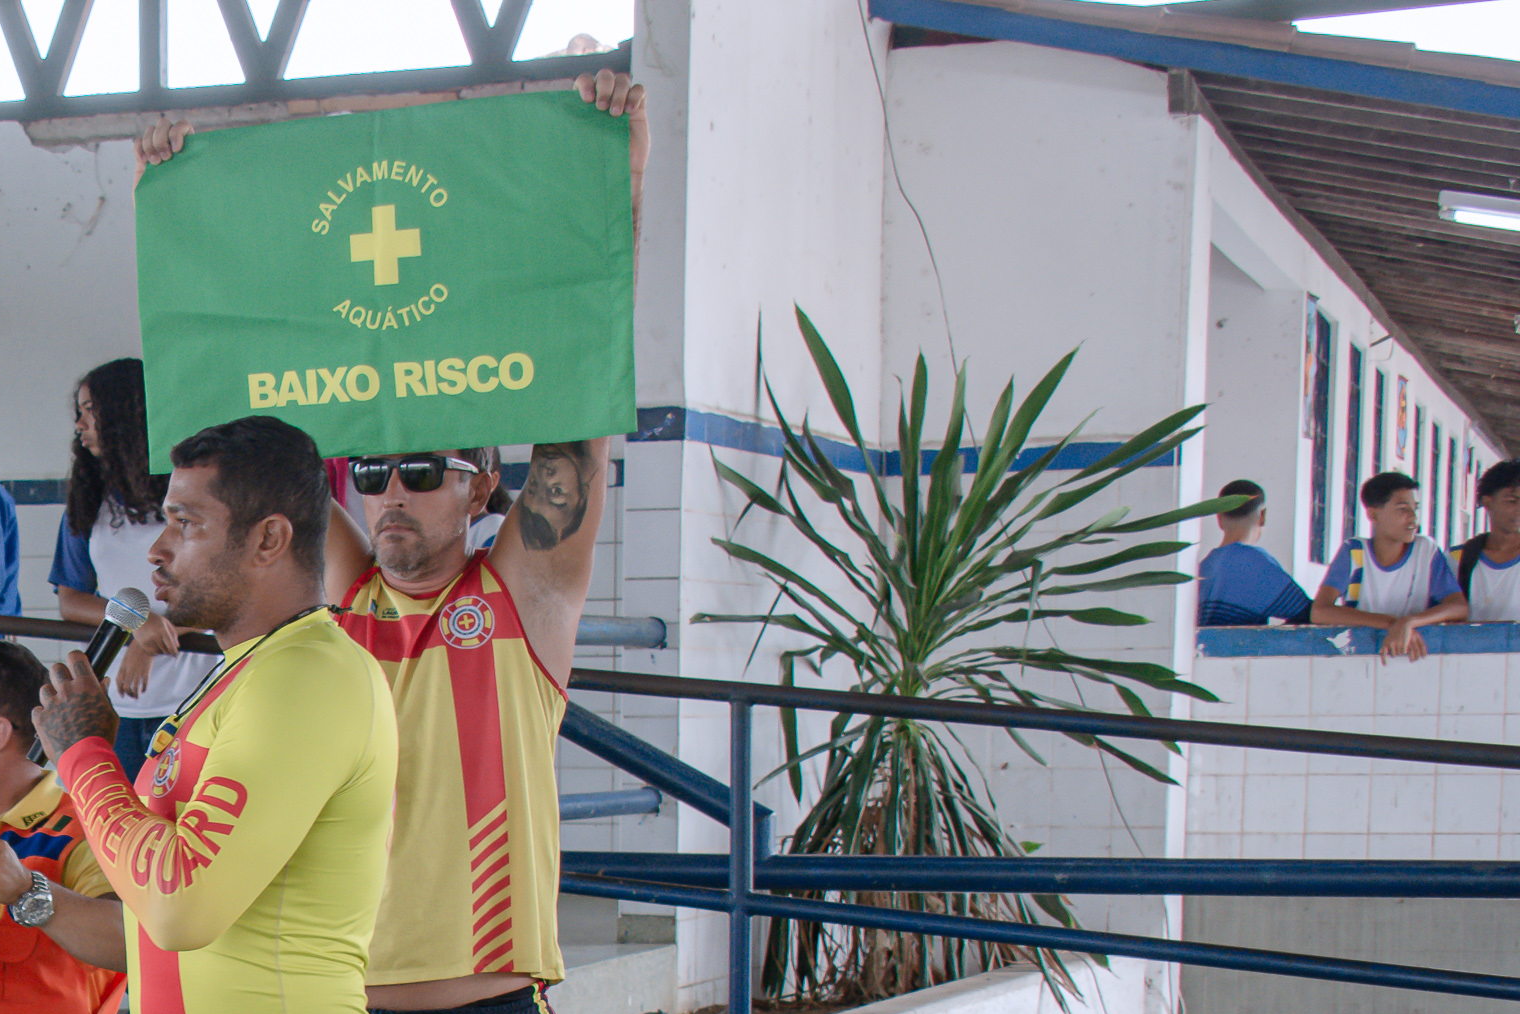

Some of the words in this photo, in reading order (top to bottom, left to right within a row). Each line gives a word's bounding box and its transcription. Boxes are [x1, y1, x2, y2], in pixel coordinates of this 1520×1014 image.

[311, 160, 448, 236] SALVAMENTO
[332, 283, 449, 331] AQUÁTICO
[247, 364, 380, 409] BAIXO
[393, 352, 535, 398] RISCO
